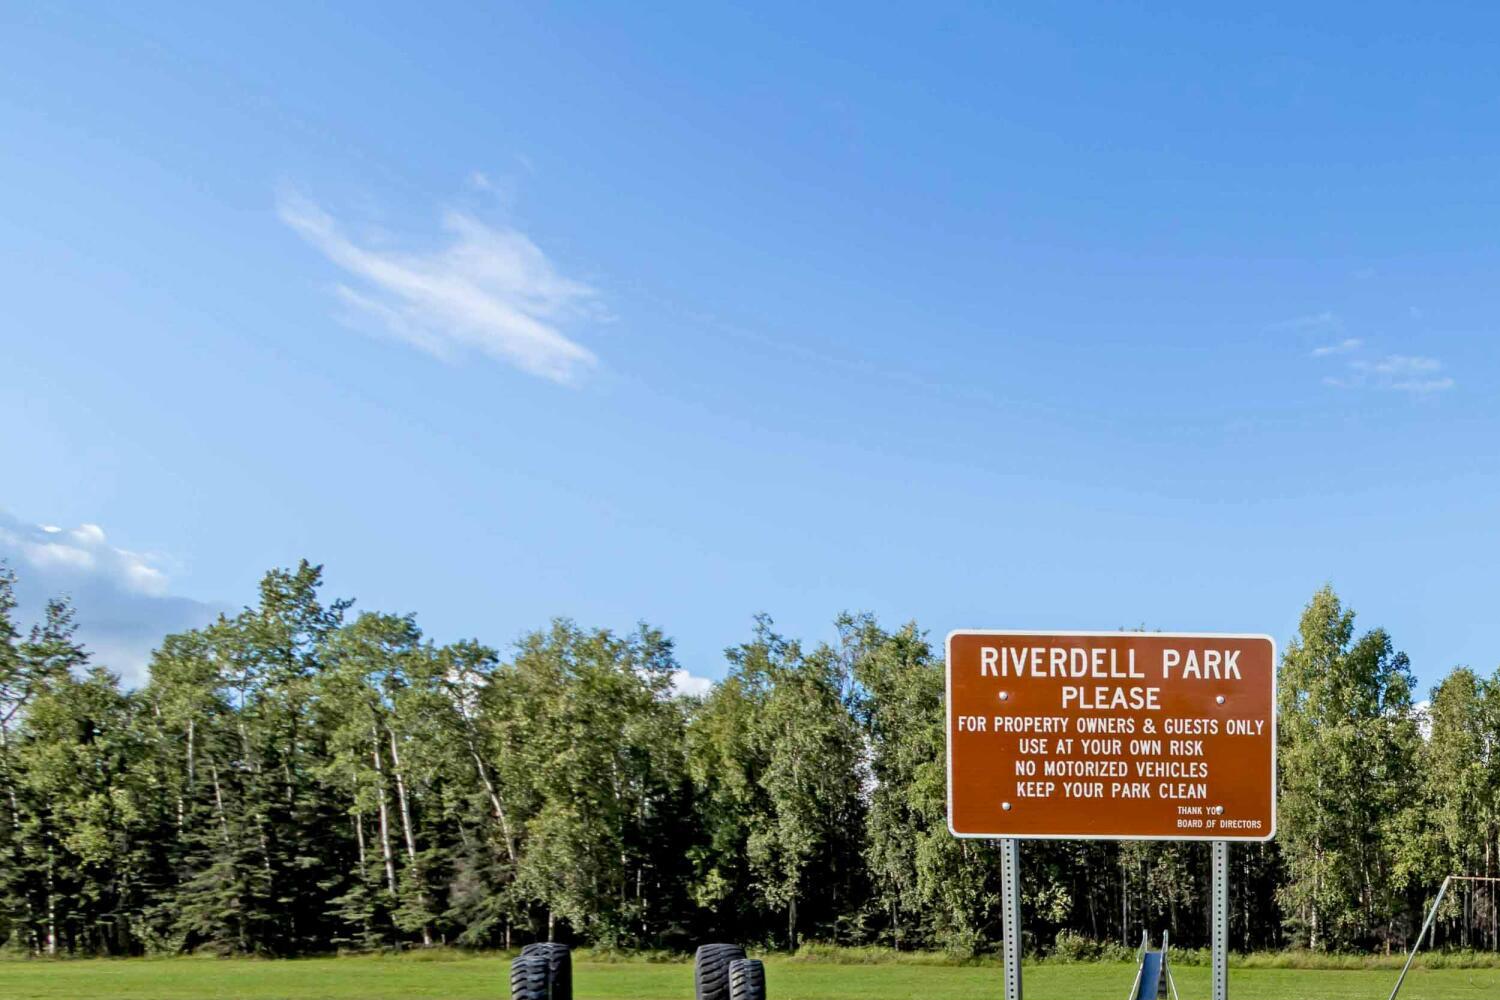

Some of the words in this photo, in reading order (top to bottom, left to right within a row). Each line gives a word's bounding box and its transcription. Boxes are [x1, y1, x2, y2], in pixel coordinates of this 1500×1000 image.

[980, 647, 1145, 679] RIVERDELL
[1162, 649, 1241, 680] PARK
[1062, 686, 1161, 710] PLEASE
[958, 716, 987, 732] FOR
[994, 717, 1068, 733] PROPERTY
[1076, 717, 1135, 734] OWNERS
[1142, 720, 1156, 734] &
[1164, 719, 1219, 734] GUESTS
[1226, 720, 1264, 735] ONLY
[1019, 739, 1048, 754] USE
[1056, 740, 1074, 754] AT
[1081, 740, 1122, 755] YOUR
[1130, 740, 1162, 756] OWN
[1170, 741, 1204, 756] RISK
[1015, 761, 1036, 776] NO
[1044, 761, 1128, 777] MOTORIZED
[1136, 762, 1208, 778] VEHICLES
[1016, 782, 1055, 797] KEEP
[1063, 783, 1103, 798] YOUR
[1111, 783, 1150, 798] PARK
[1159, 784, 1207, 799] CLEAN
[1177, 806, 1202, 815] THANK
[1205, 807, 1221, 815] YO
[1177, 820, 1203, 828] BOARD
[1206, 820, 1217, 828] OF
[1219, 820, 1262, 829] DIRECTORS
